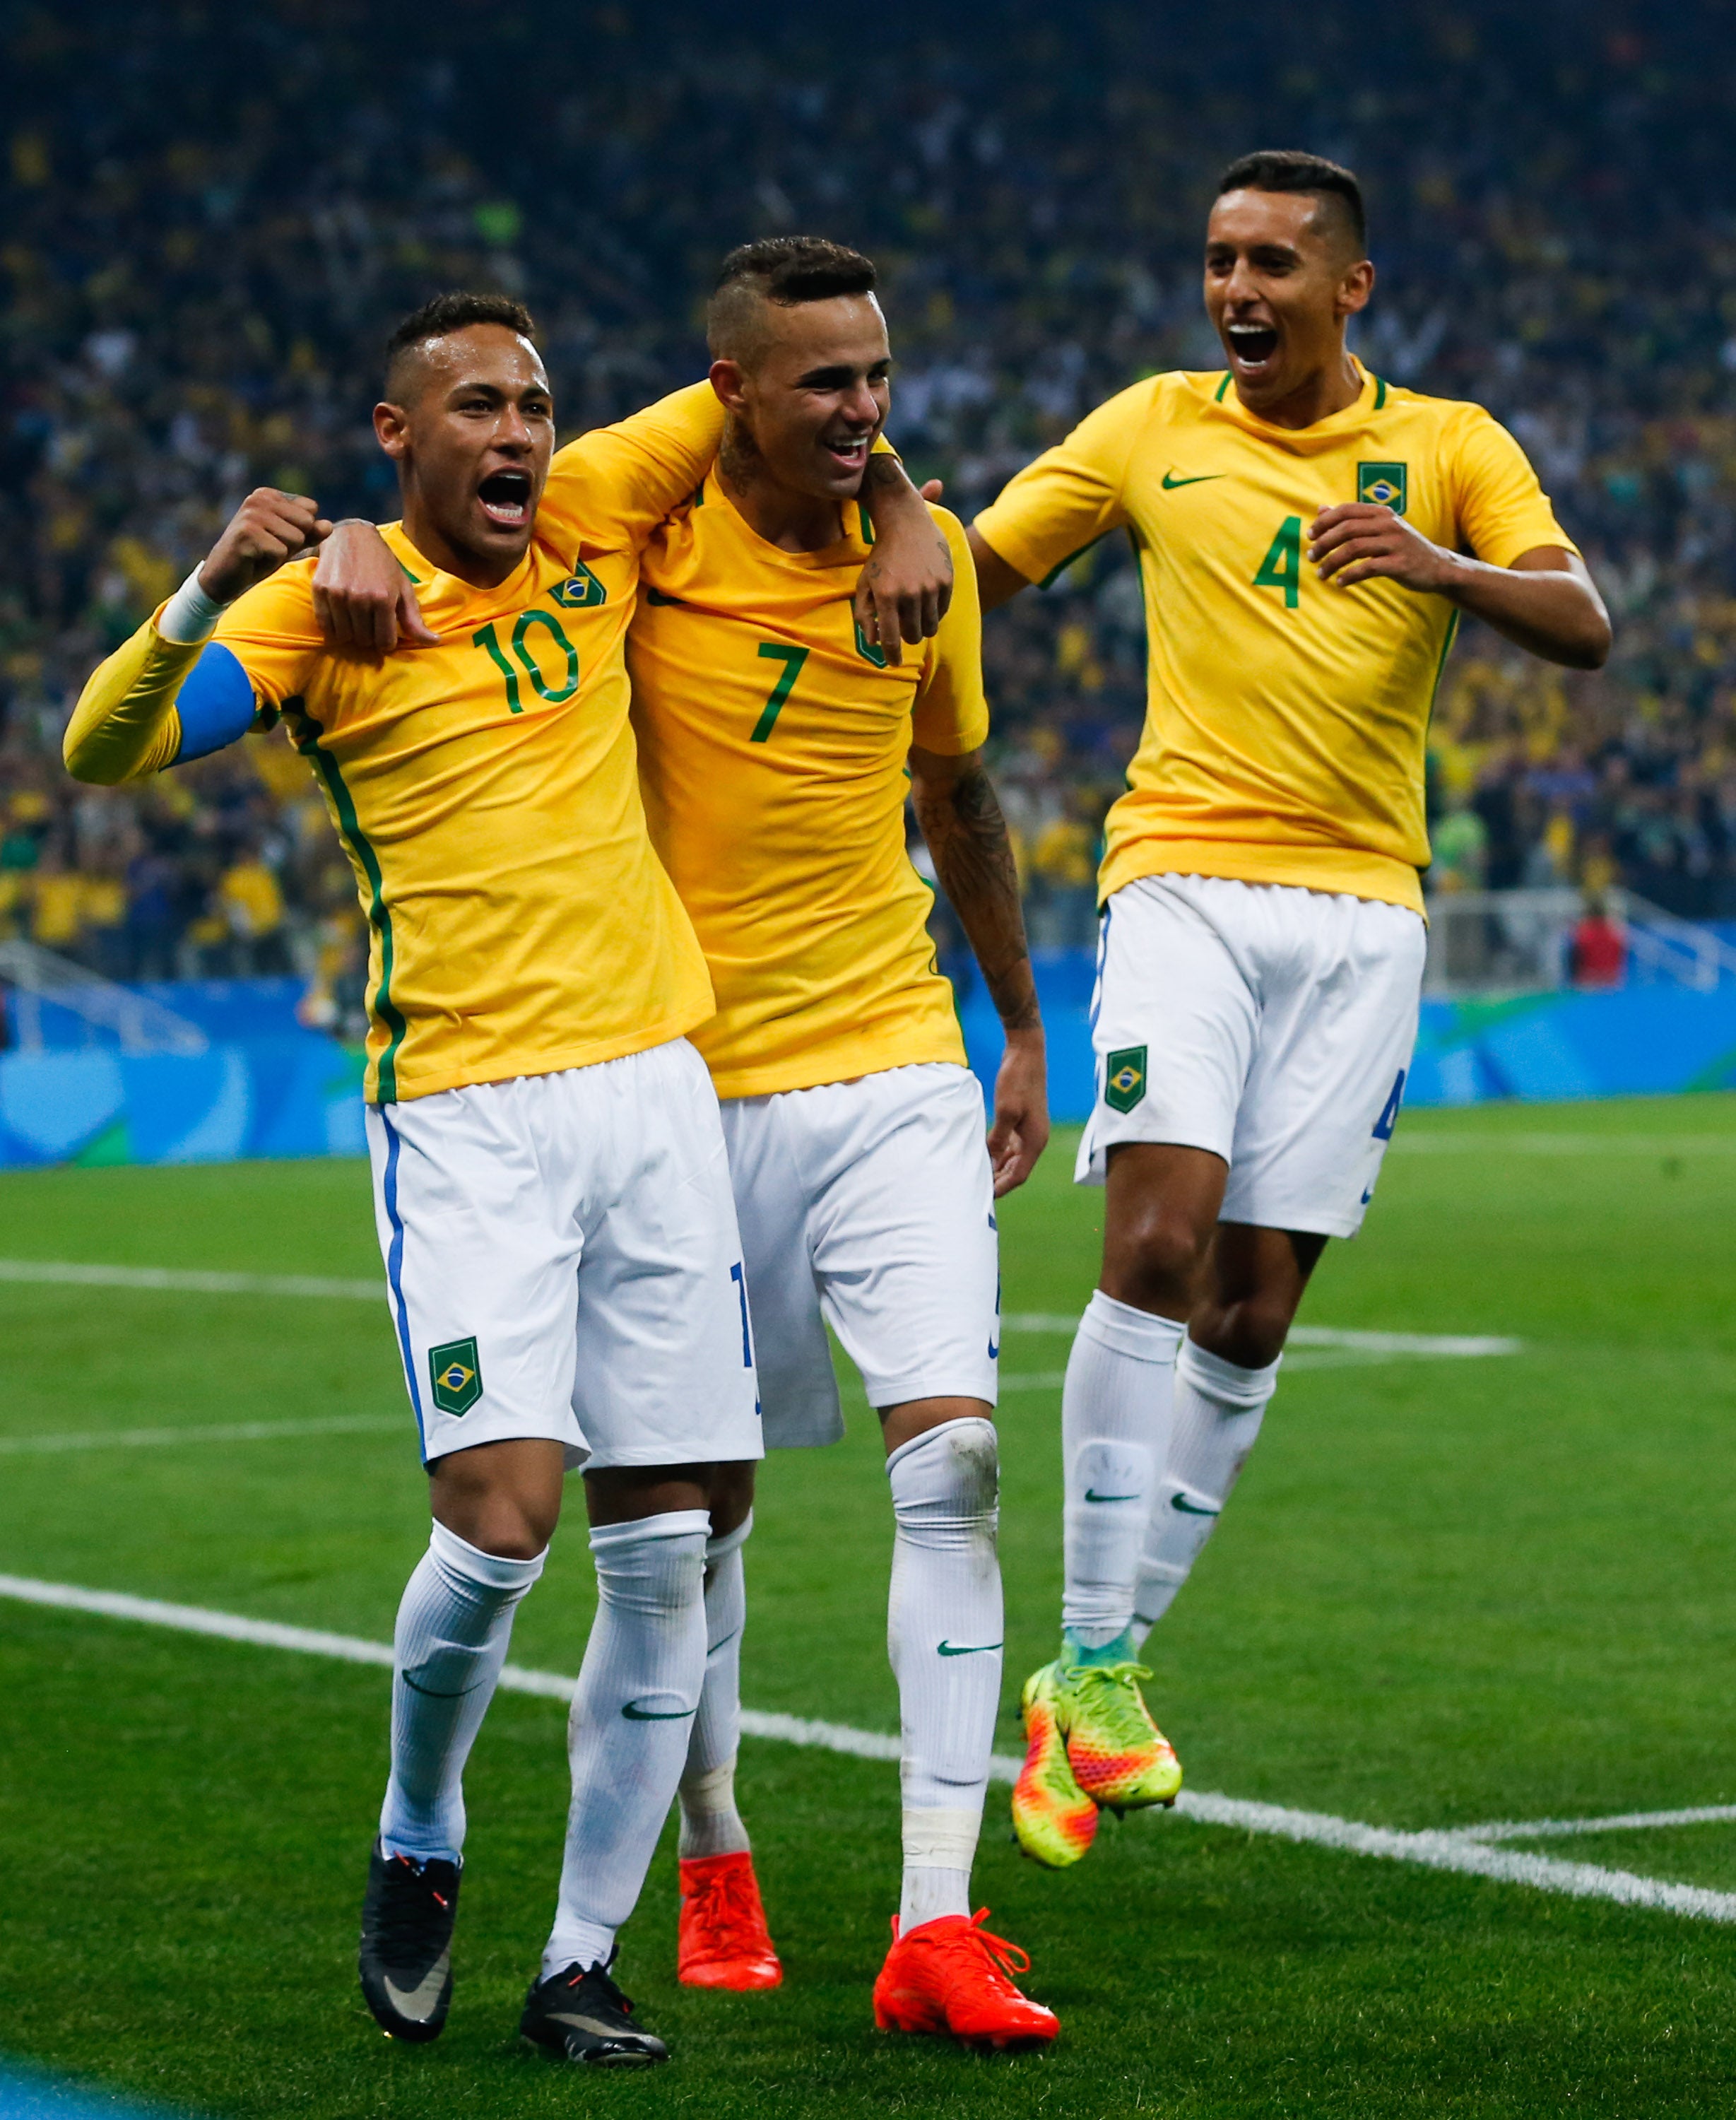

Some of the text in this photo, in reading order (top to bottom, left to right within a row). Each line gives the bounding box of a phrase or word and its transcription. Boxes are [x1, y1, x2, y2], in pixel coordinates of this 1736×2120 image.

[1253, 516, 1301, 608] 4
[472, 609, 579, 714] 10
[750, 642, 810, 743] 7
